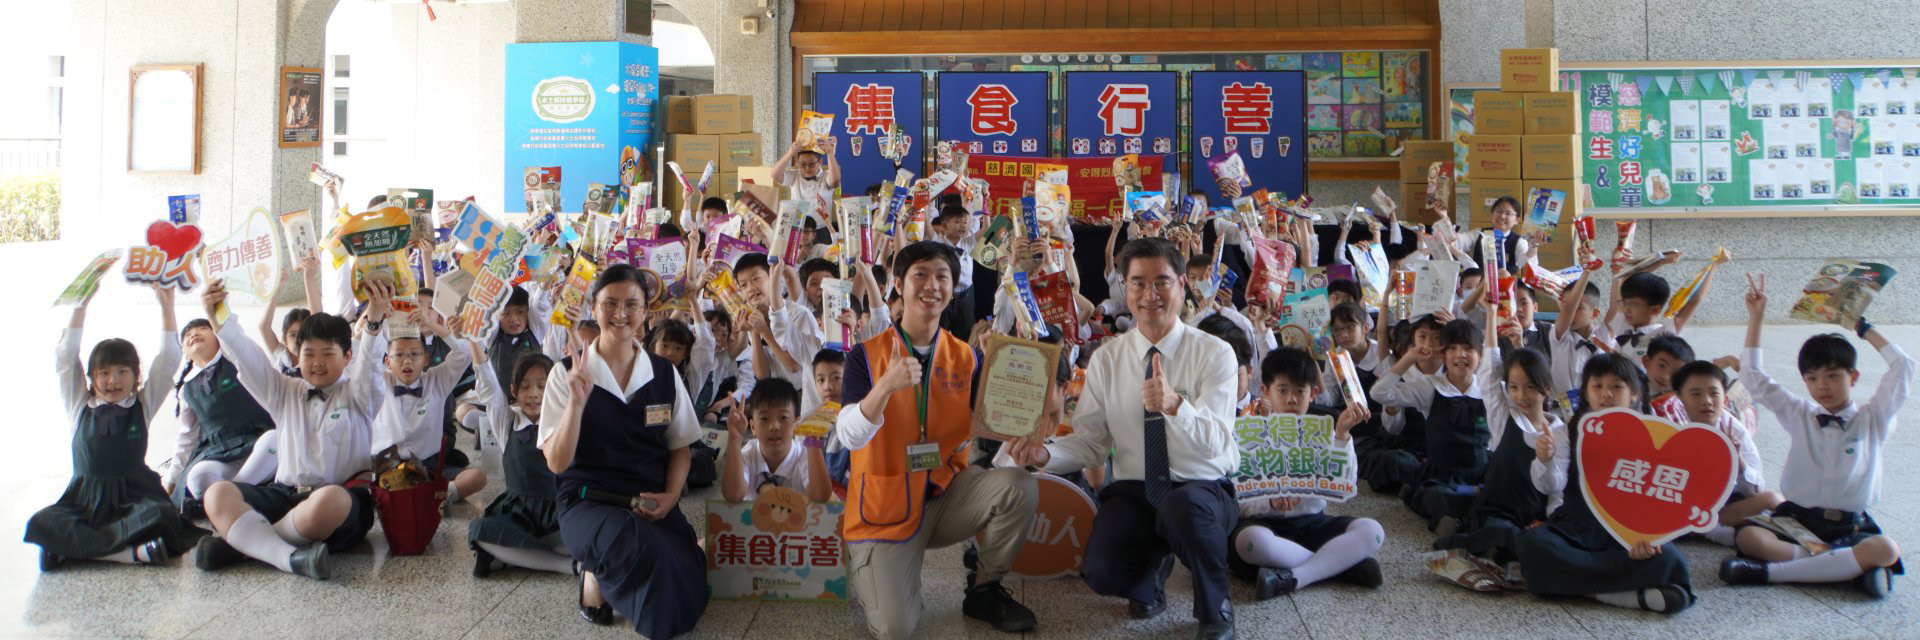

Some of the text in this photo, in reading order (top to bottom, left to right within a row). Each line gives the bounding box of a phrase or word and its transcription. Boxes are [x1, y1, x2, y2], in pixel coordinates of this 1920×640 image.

[844, 82, 1273, 136] 集 食 行 善
[1618, 82, 1643, 208] 慈濟好兒童
[126, 247, 197, 284] 助人
[207, 233, 273, 277] 齊力傳善
[1233, 415, 1333, 446] 安得烈
[1236, 477, 1354, 493] ndrew Food Bank
[1606, 458, 1691, 505] 感恩
[716, 533, 840, 567] 集食行善
